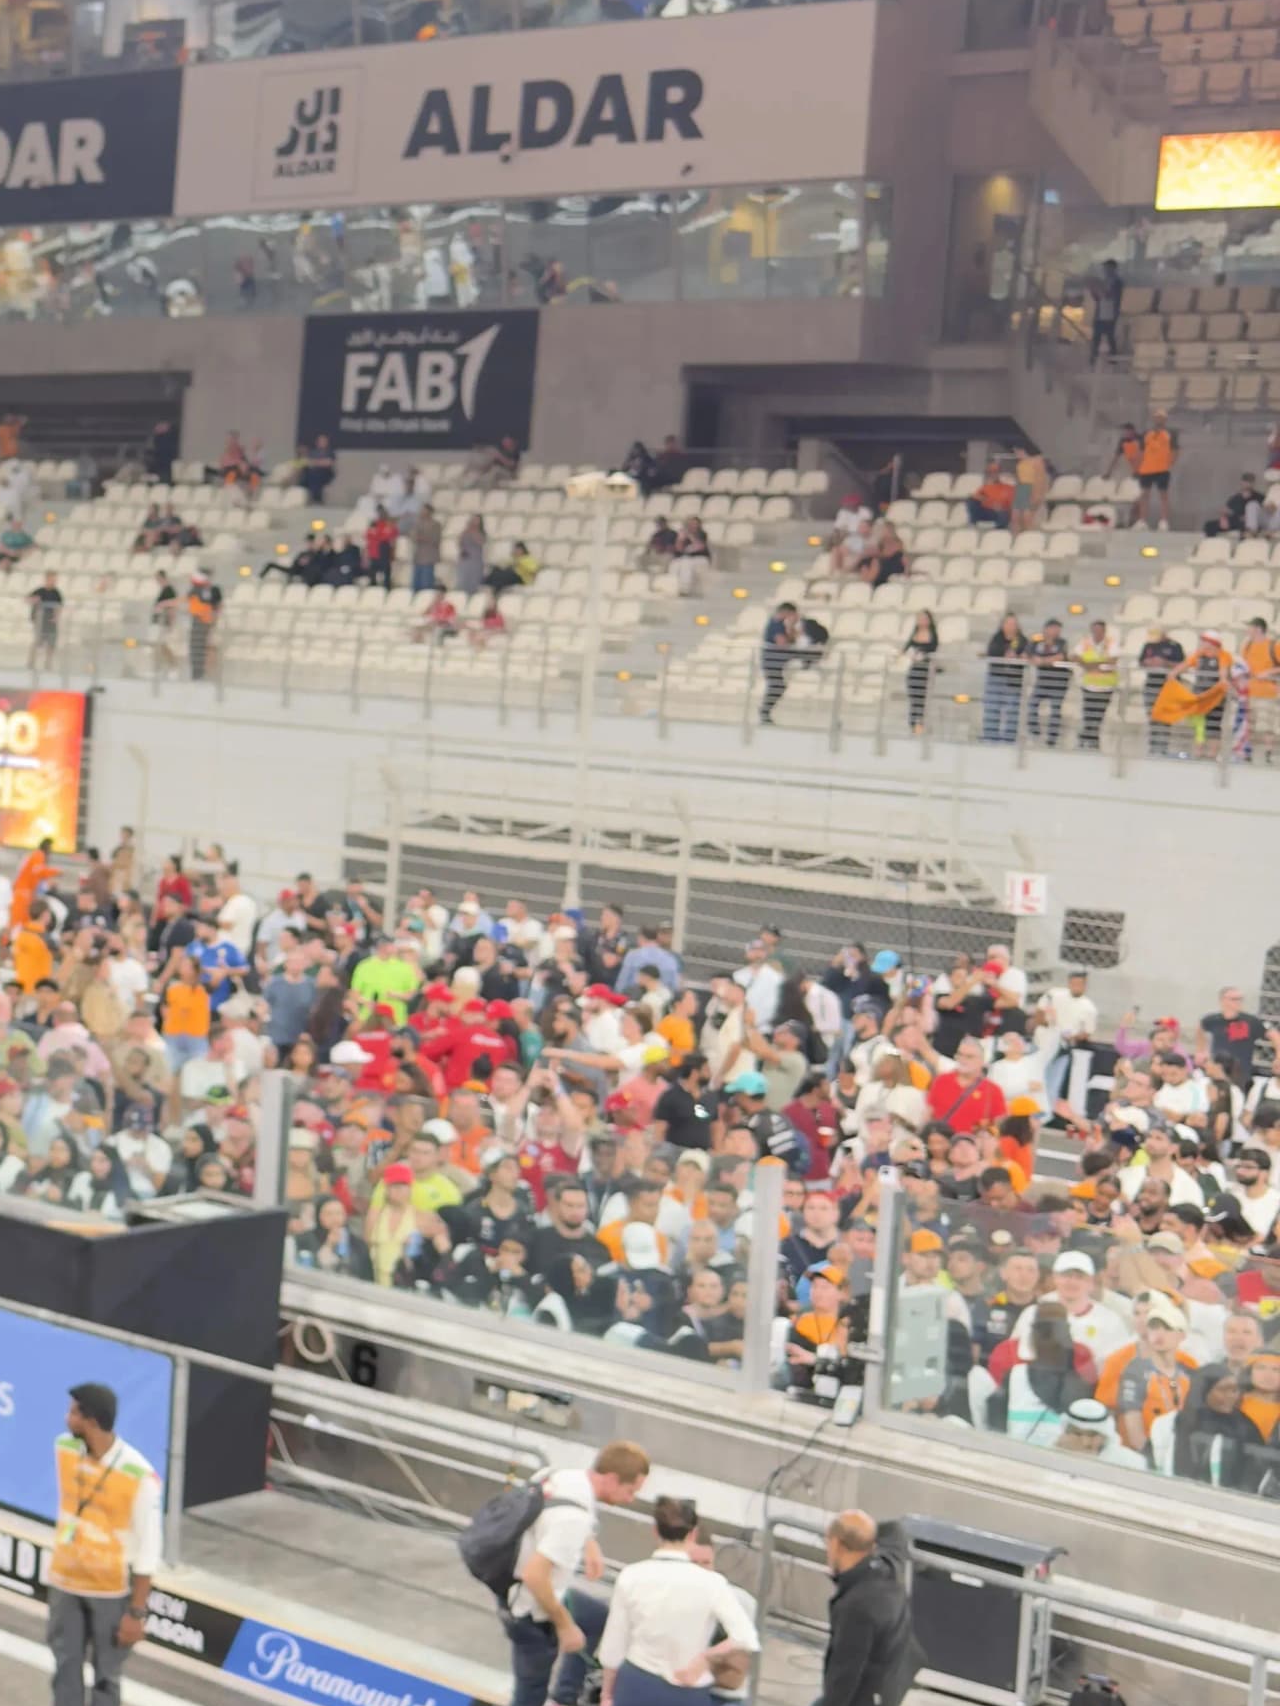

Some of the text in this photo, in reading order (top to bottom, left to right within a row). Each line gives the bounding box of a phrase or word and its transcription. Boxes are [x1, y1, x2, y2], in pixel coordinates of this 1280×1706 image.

[401, 68, 705, 160] ALDAR
[272, 158, 337, 179] ALDAR
[341, 351, 457, 413] FAB
[351, 1341, 378, 1389] 6
[144, 1614, 205, 1654] ASON
